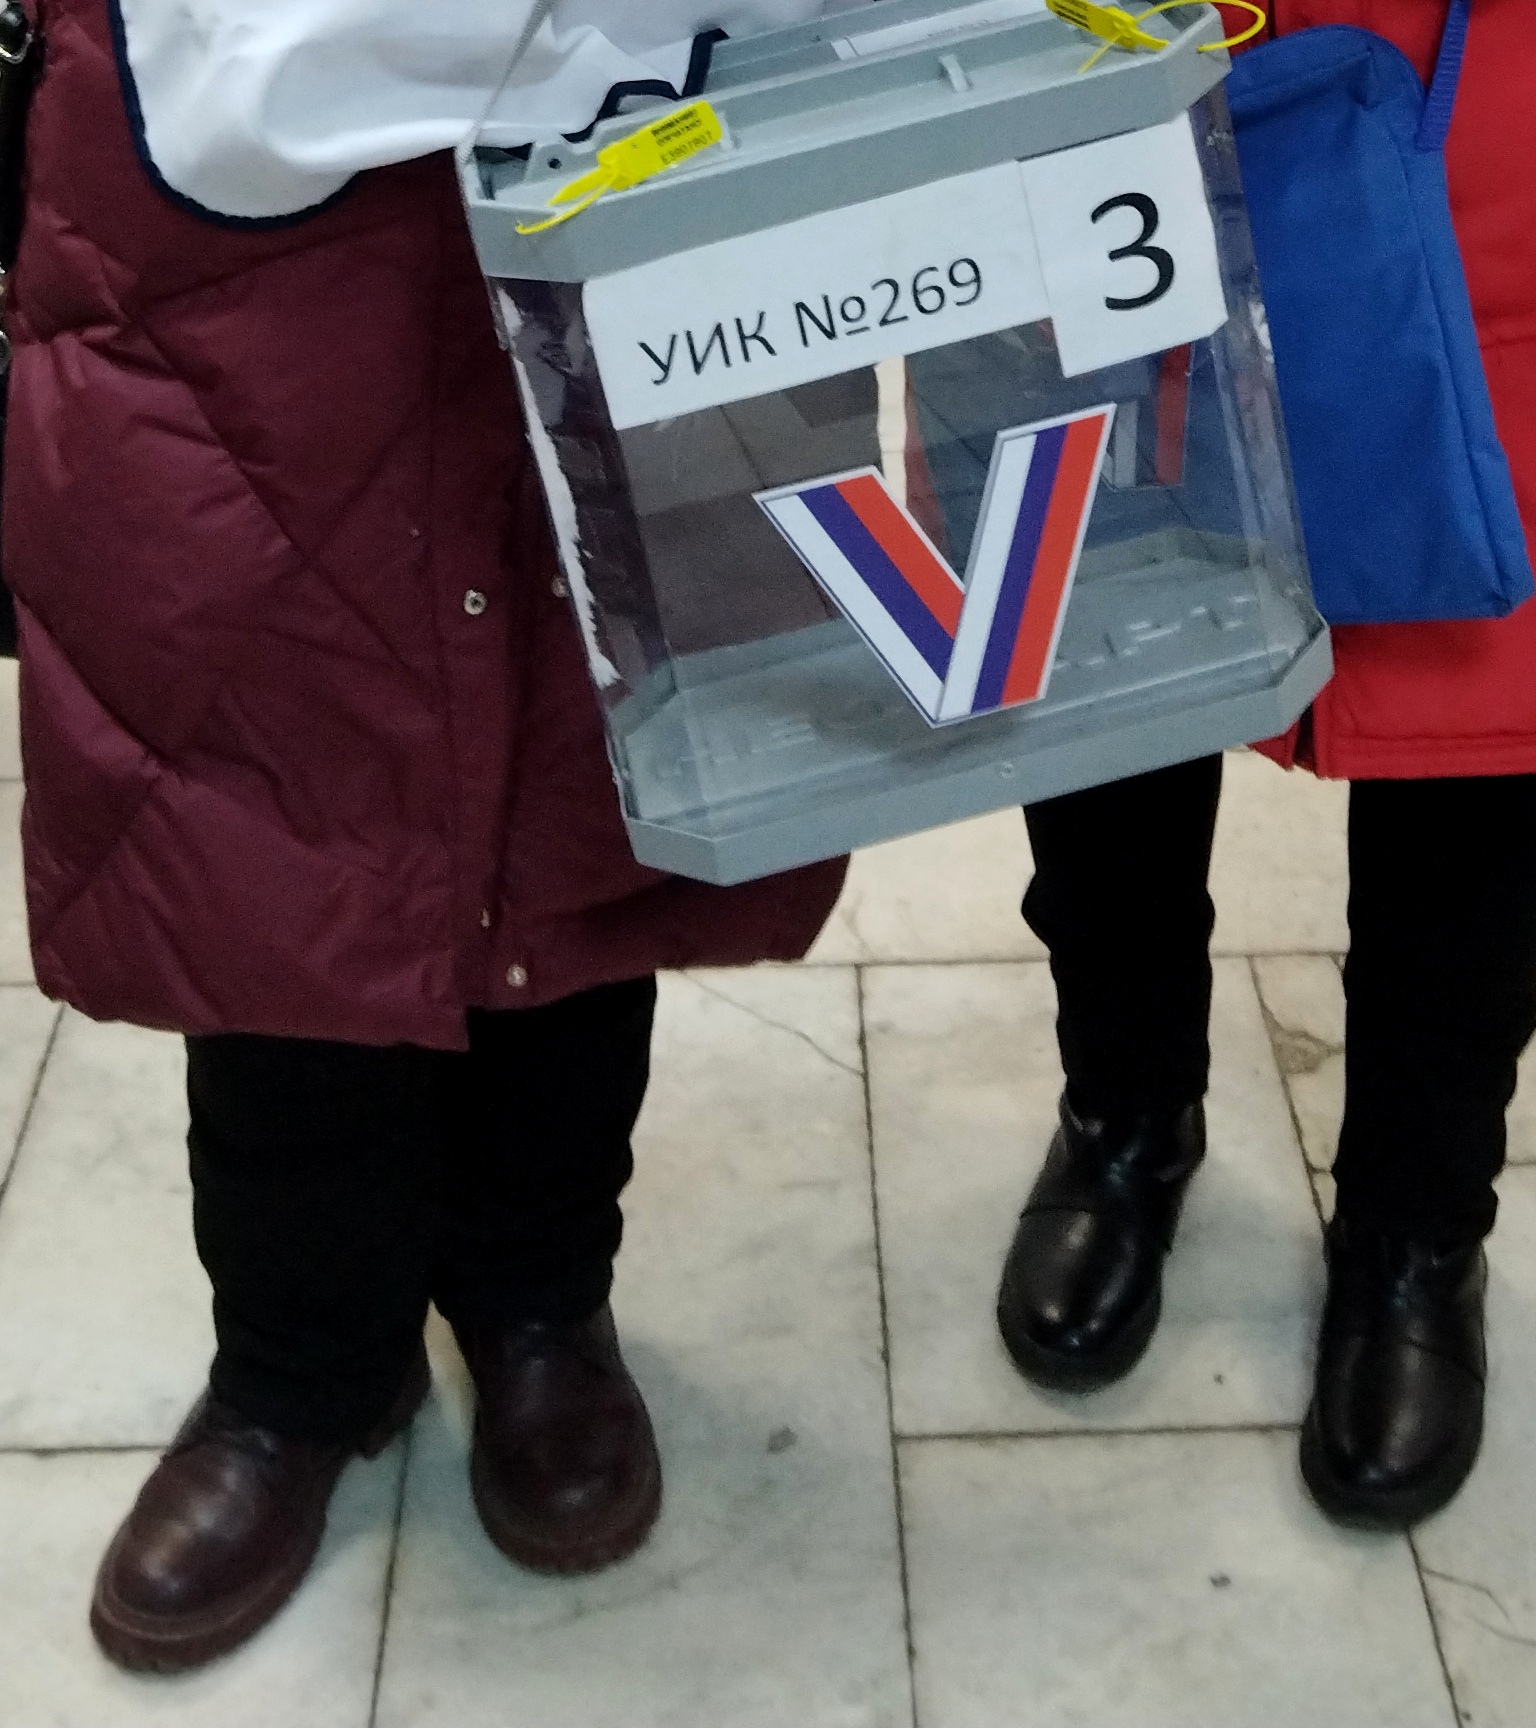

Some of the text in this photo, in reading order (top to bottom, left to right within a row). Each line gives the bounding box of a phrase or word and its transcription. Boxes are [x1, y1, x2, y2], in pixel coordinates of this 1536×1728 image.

[1091, 192, 1175, 311] 3
[638, 258, 982, 386] УИК №269
